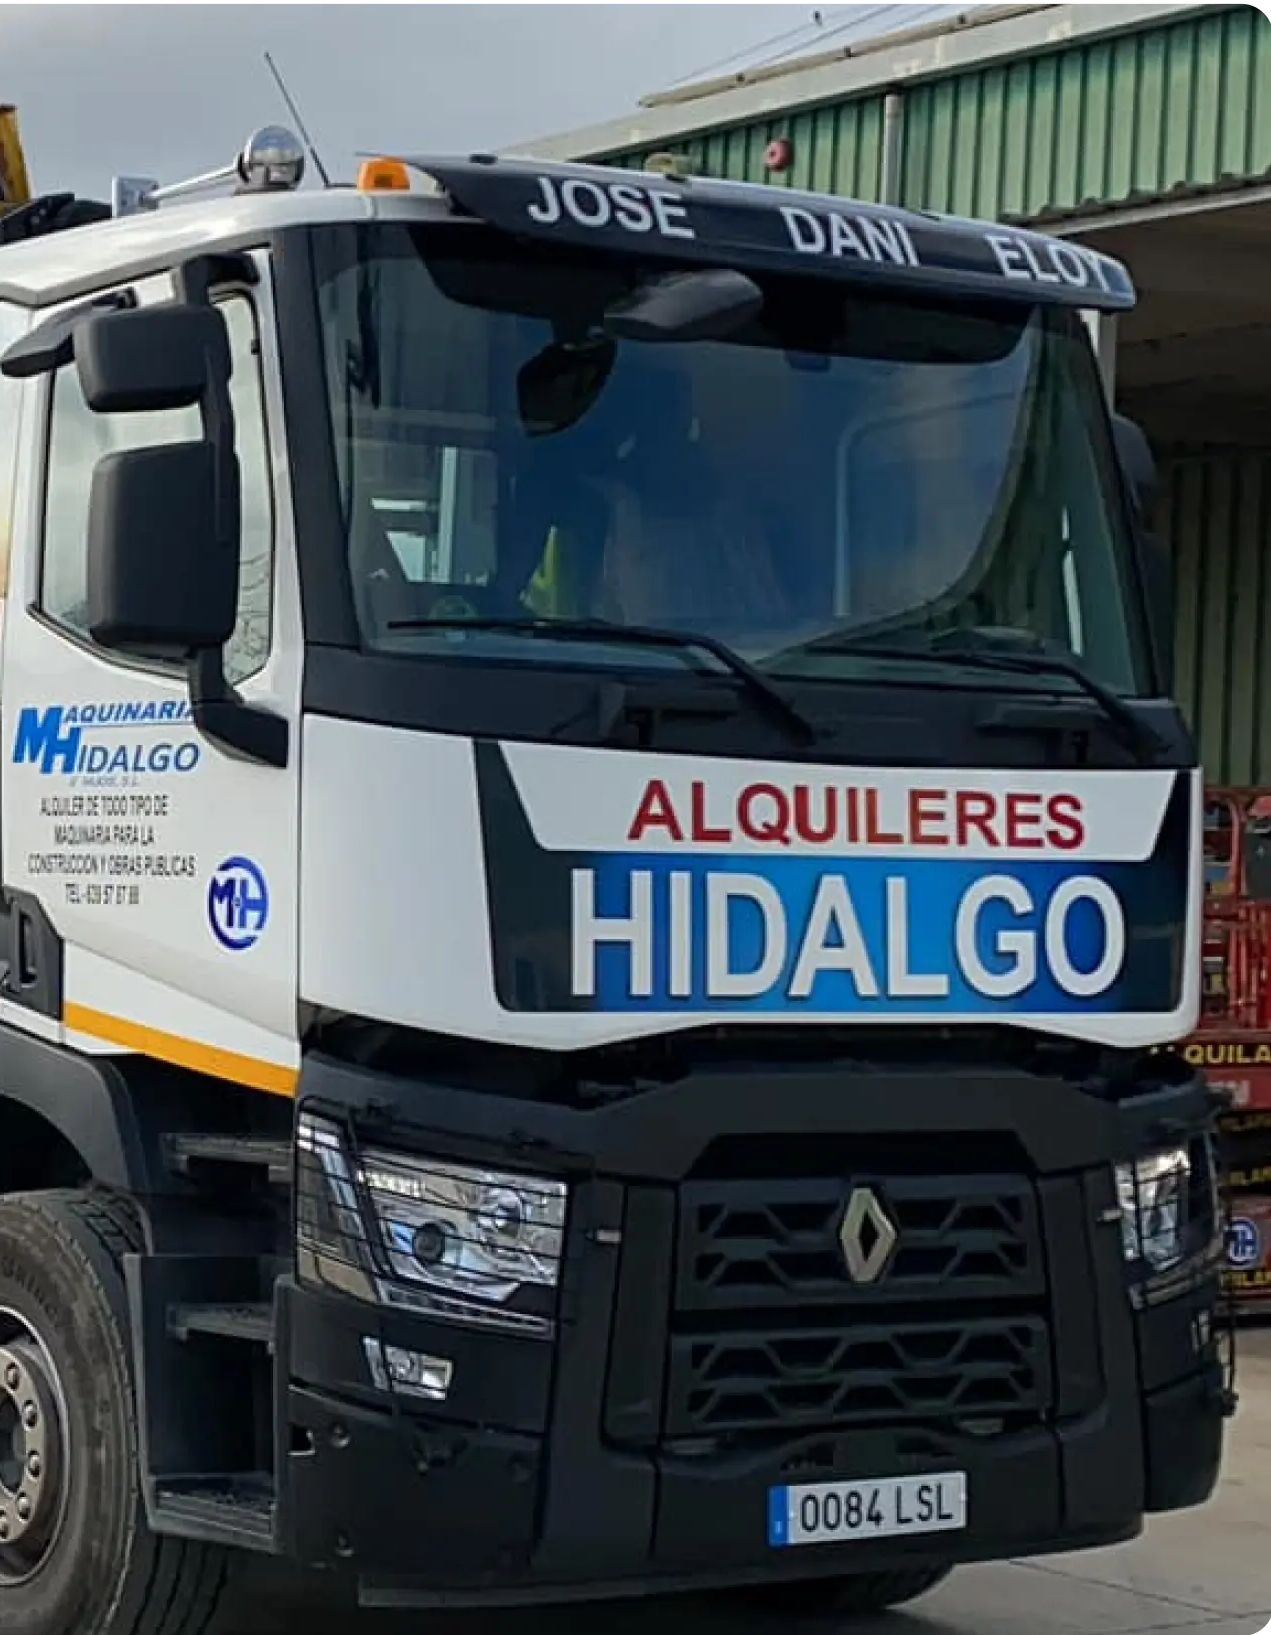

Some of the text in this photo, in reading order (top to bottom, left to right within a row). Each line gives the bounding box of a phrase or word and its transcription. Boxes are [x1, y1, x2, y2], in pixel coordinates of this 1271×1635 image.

[528, 175, 1110, 294] JOSE DANI ELOY
[40, 726, 201, 774] HIDALGO
[40, 795, 169, 816] ALQUILER DE TODO TIPO DE
[627, 778, 1086, 850] ALQUILERES
[54, 824, 155, 845] MAQUINARIA PARA LA
[109, 855, 142, 875] OBRAS
[571, 867, 1126, 999] HIDALGO
[801, 1483, 953, 1533] 0084 LSL
